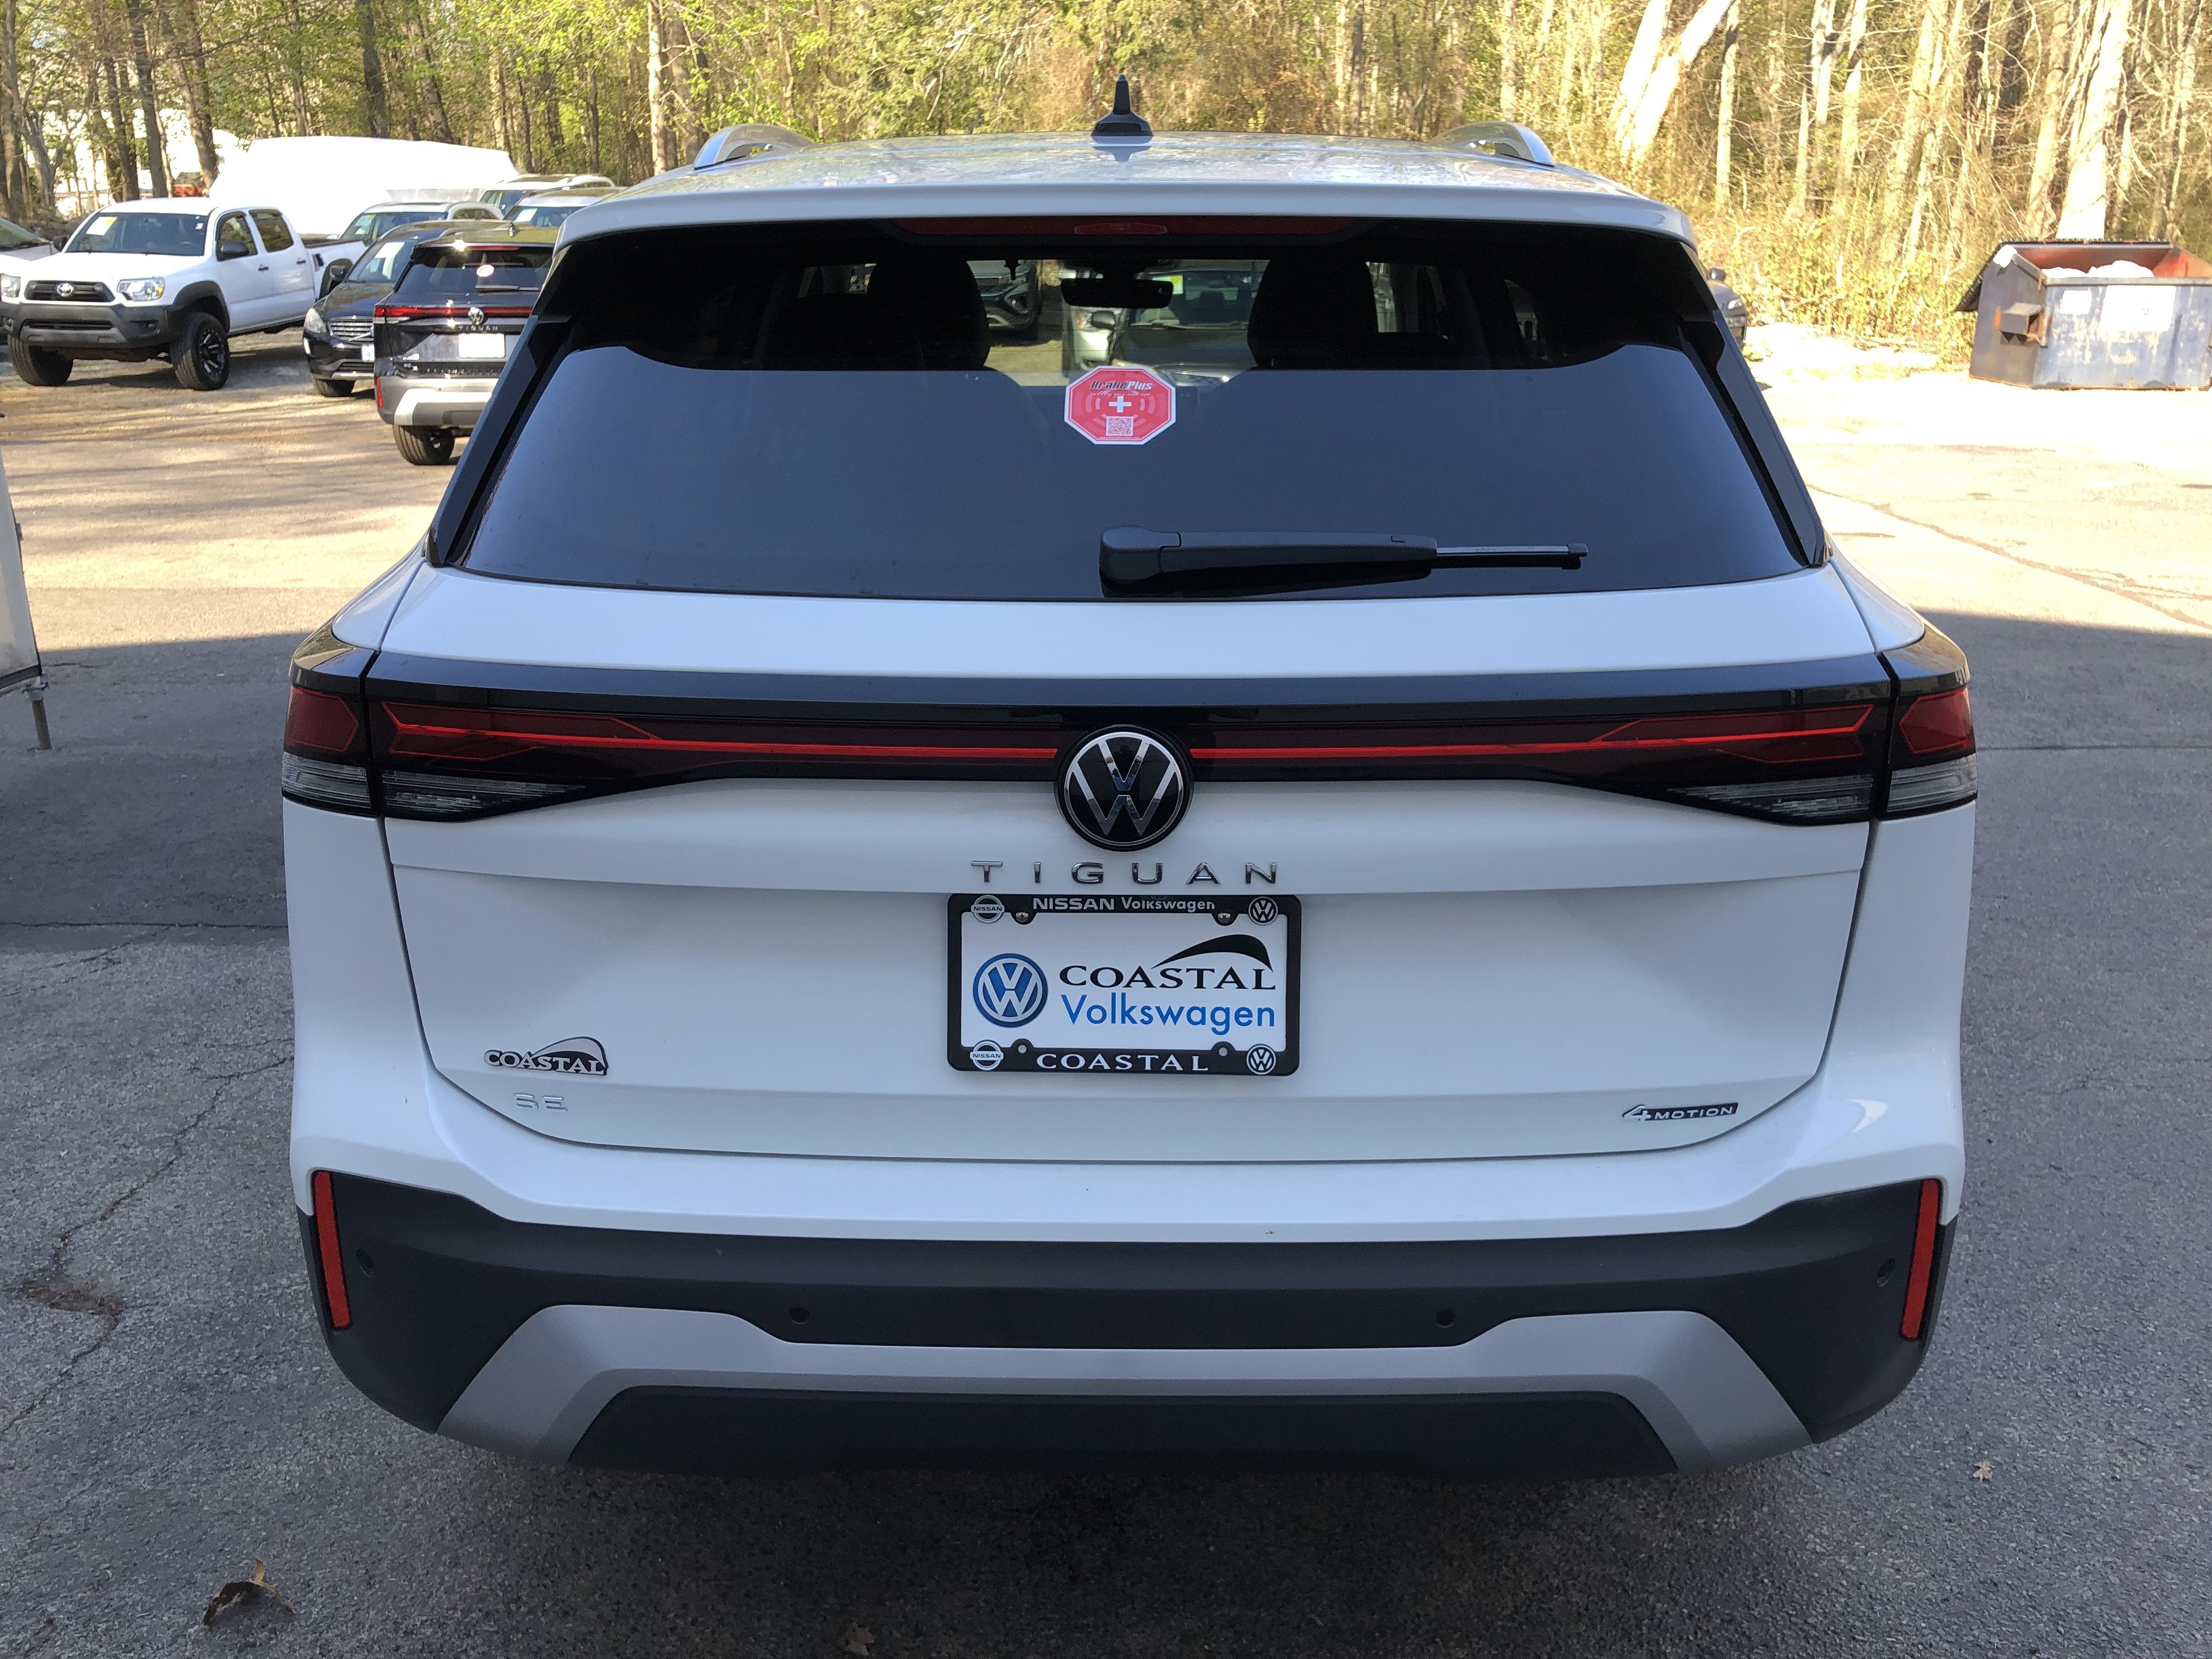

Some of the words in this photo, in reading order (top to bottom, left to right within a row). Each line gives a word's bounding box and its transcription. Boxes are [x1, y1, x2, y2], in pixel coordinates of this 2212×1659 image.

[1090, 380, 1153, 390] BrakePlus
[971, 860, 1277, 885] TIGUAN
[1033, 897, 1114, 910] NISSAN
[1120, 896, 1215, 913] Volkswagen
[1059, 964, 1276, 990] COASTAL
[1060, 991, 1275, 1036] Volkswagen
[483, 1049, 607, 1076] COASTAL
[1036, 1053, 1209, 1071] COASTAL
[514, 1092, 568, 1112] SE
[1622, 1104, 1734, 1121] 4MOTION
